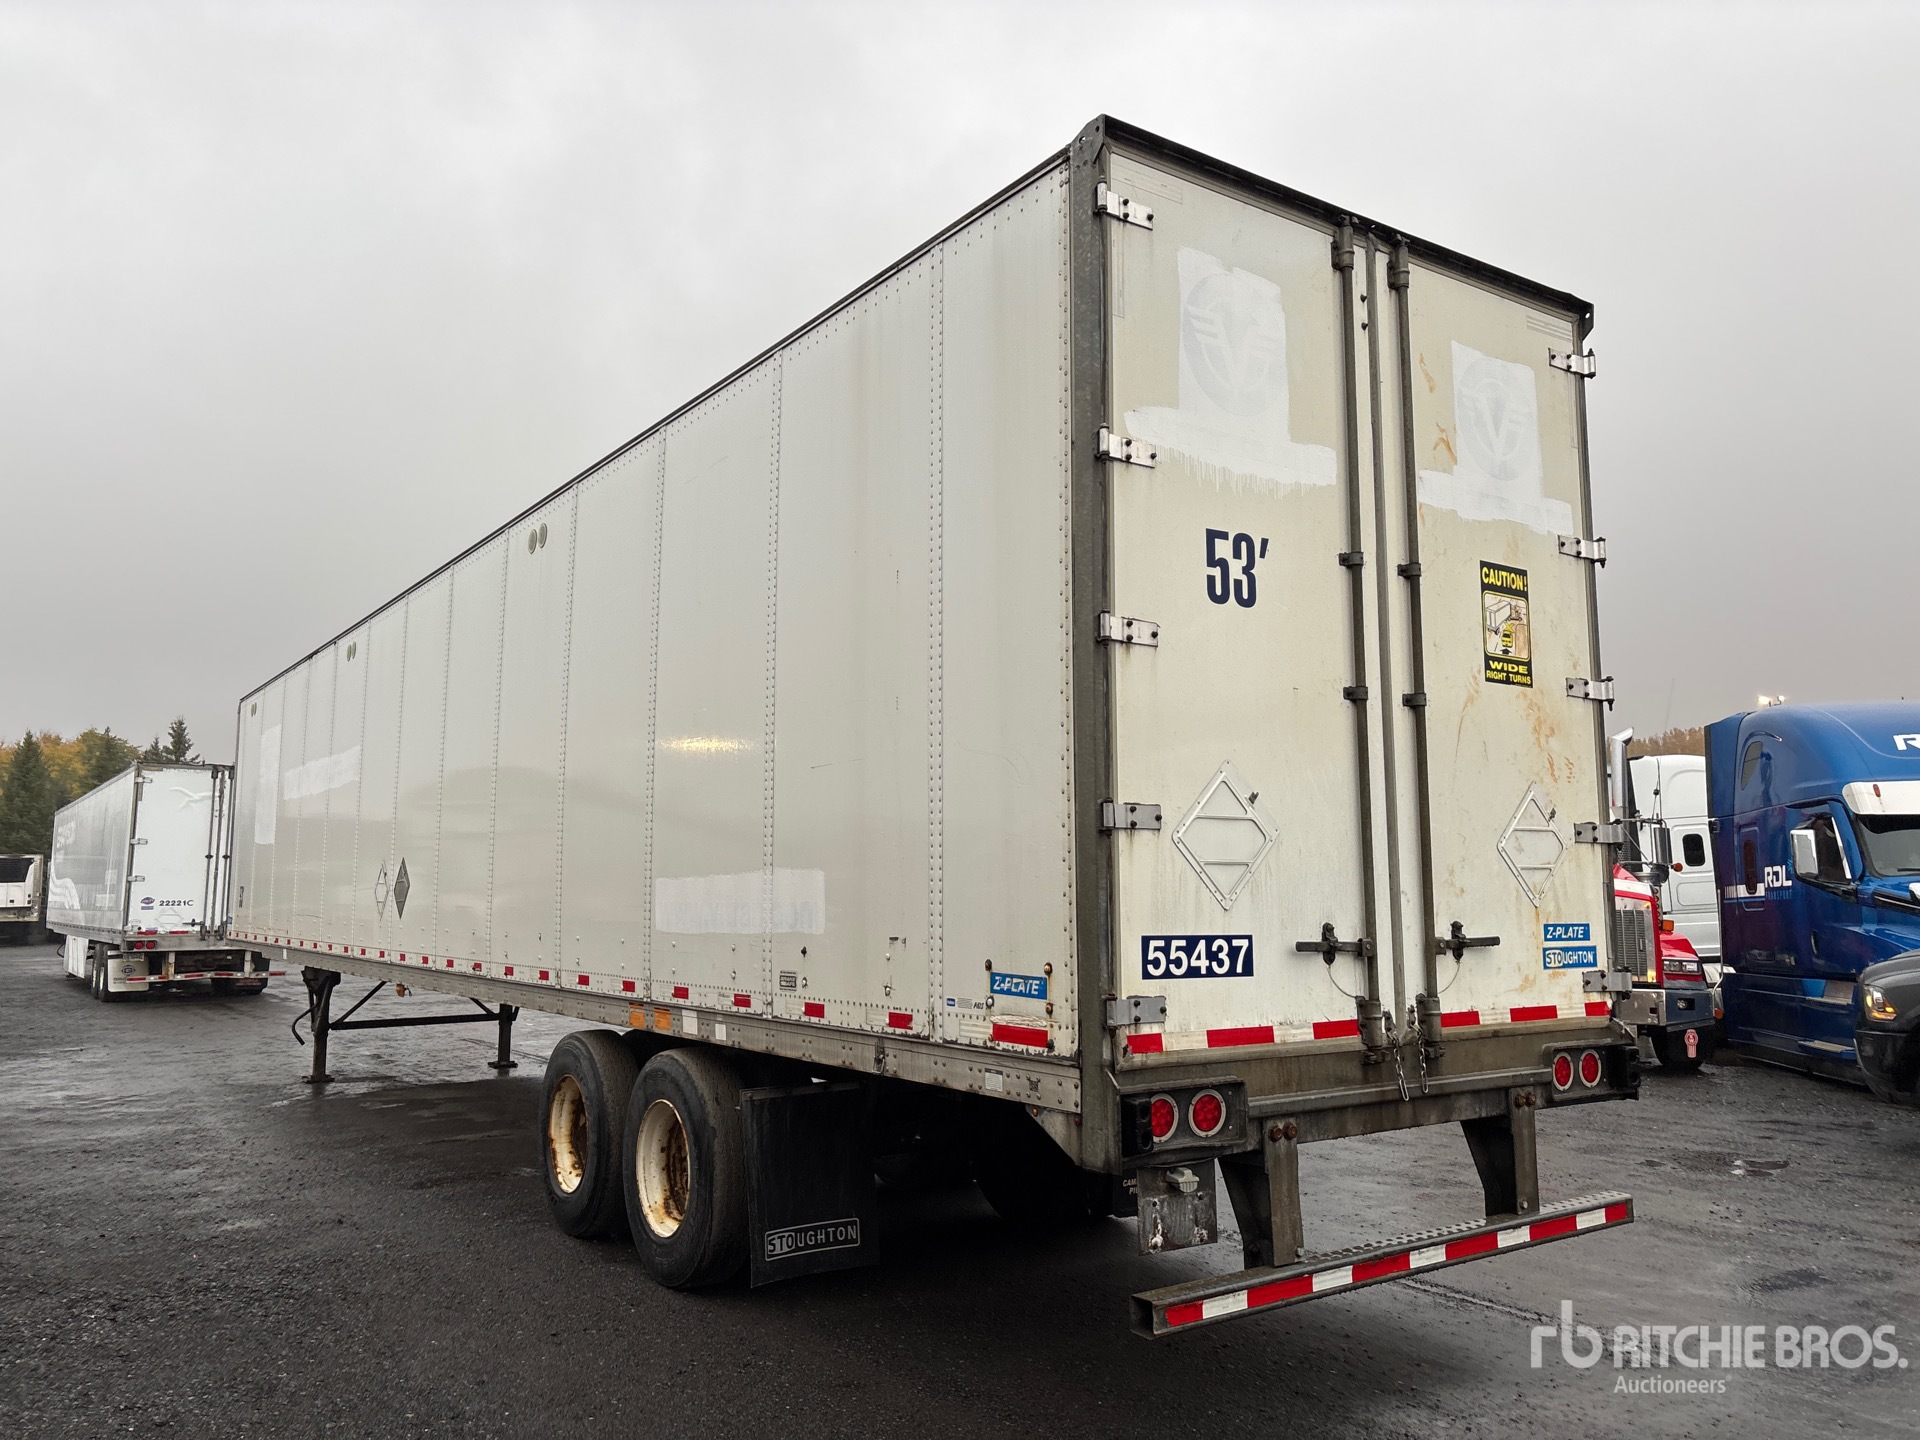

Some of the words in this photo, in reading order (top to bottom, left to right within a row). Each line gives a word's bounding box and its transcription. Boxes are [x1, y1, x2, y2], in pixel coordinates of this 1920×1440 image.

[1205, 528, 1269, 609] 53'
[1481, 566, 1528, 592] CAUTION!
[1489, 660, 1528, 674] WIDE
[1486, 670, 1507, 681] RIGHT
[1508, 673, 1531, 685] TURNS
[1764, 865, 1793, 888] RDL
[158, 899, 195, 907] 22221C
[1546, 926, 1585, 939] Z-PLATE
[1146, 938, 1249, 977] 55437
[1545, 950, 1595, 966] STOUGHTON
[993, 976, 1040, 995] Z-PLATE
[768, 1225, 857, 1254] STOUGHTON
